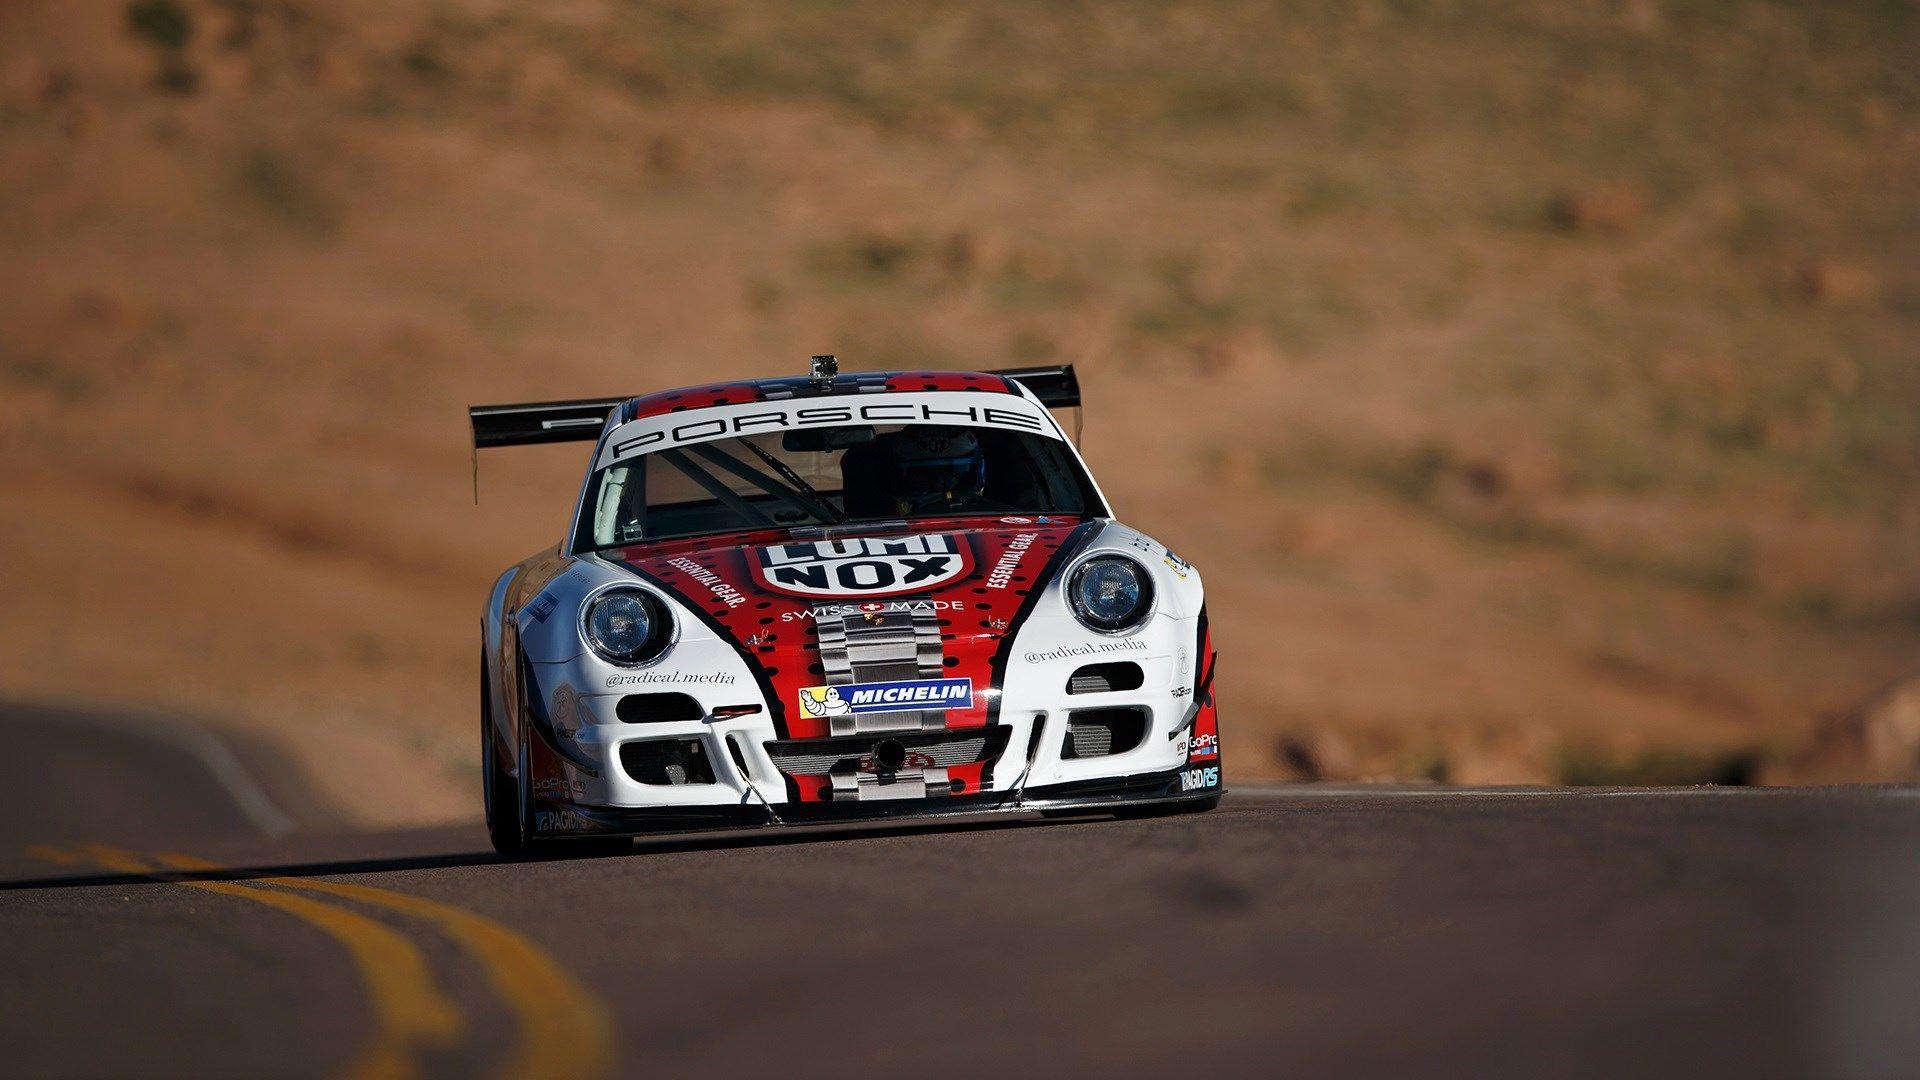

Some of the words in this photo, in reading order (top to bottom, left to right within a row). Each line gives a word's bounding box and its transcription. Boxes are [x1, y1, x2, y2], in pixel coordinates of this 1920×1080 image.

[612, 404, 1042, 459] PORSCHE
[766, 534, 949, 565] LUMI
[667, 556, 717, 588] ESSENTIAL
[774, 556, 951, 590] NOX
[986, 549, 1025, 589] ESSENTIAL
[781, 604, 855, 622] SWISS
[890, 600, 965, 611] MADE
[1024, 637, 1148, 664] @radical.media
[605, 670, 736, 688] @radical.media
[851, 685, 968, 704] MICHELIN
[1189, 733, 1218, 749] GoPro
